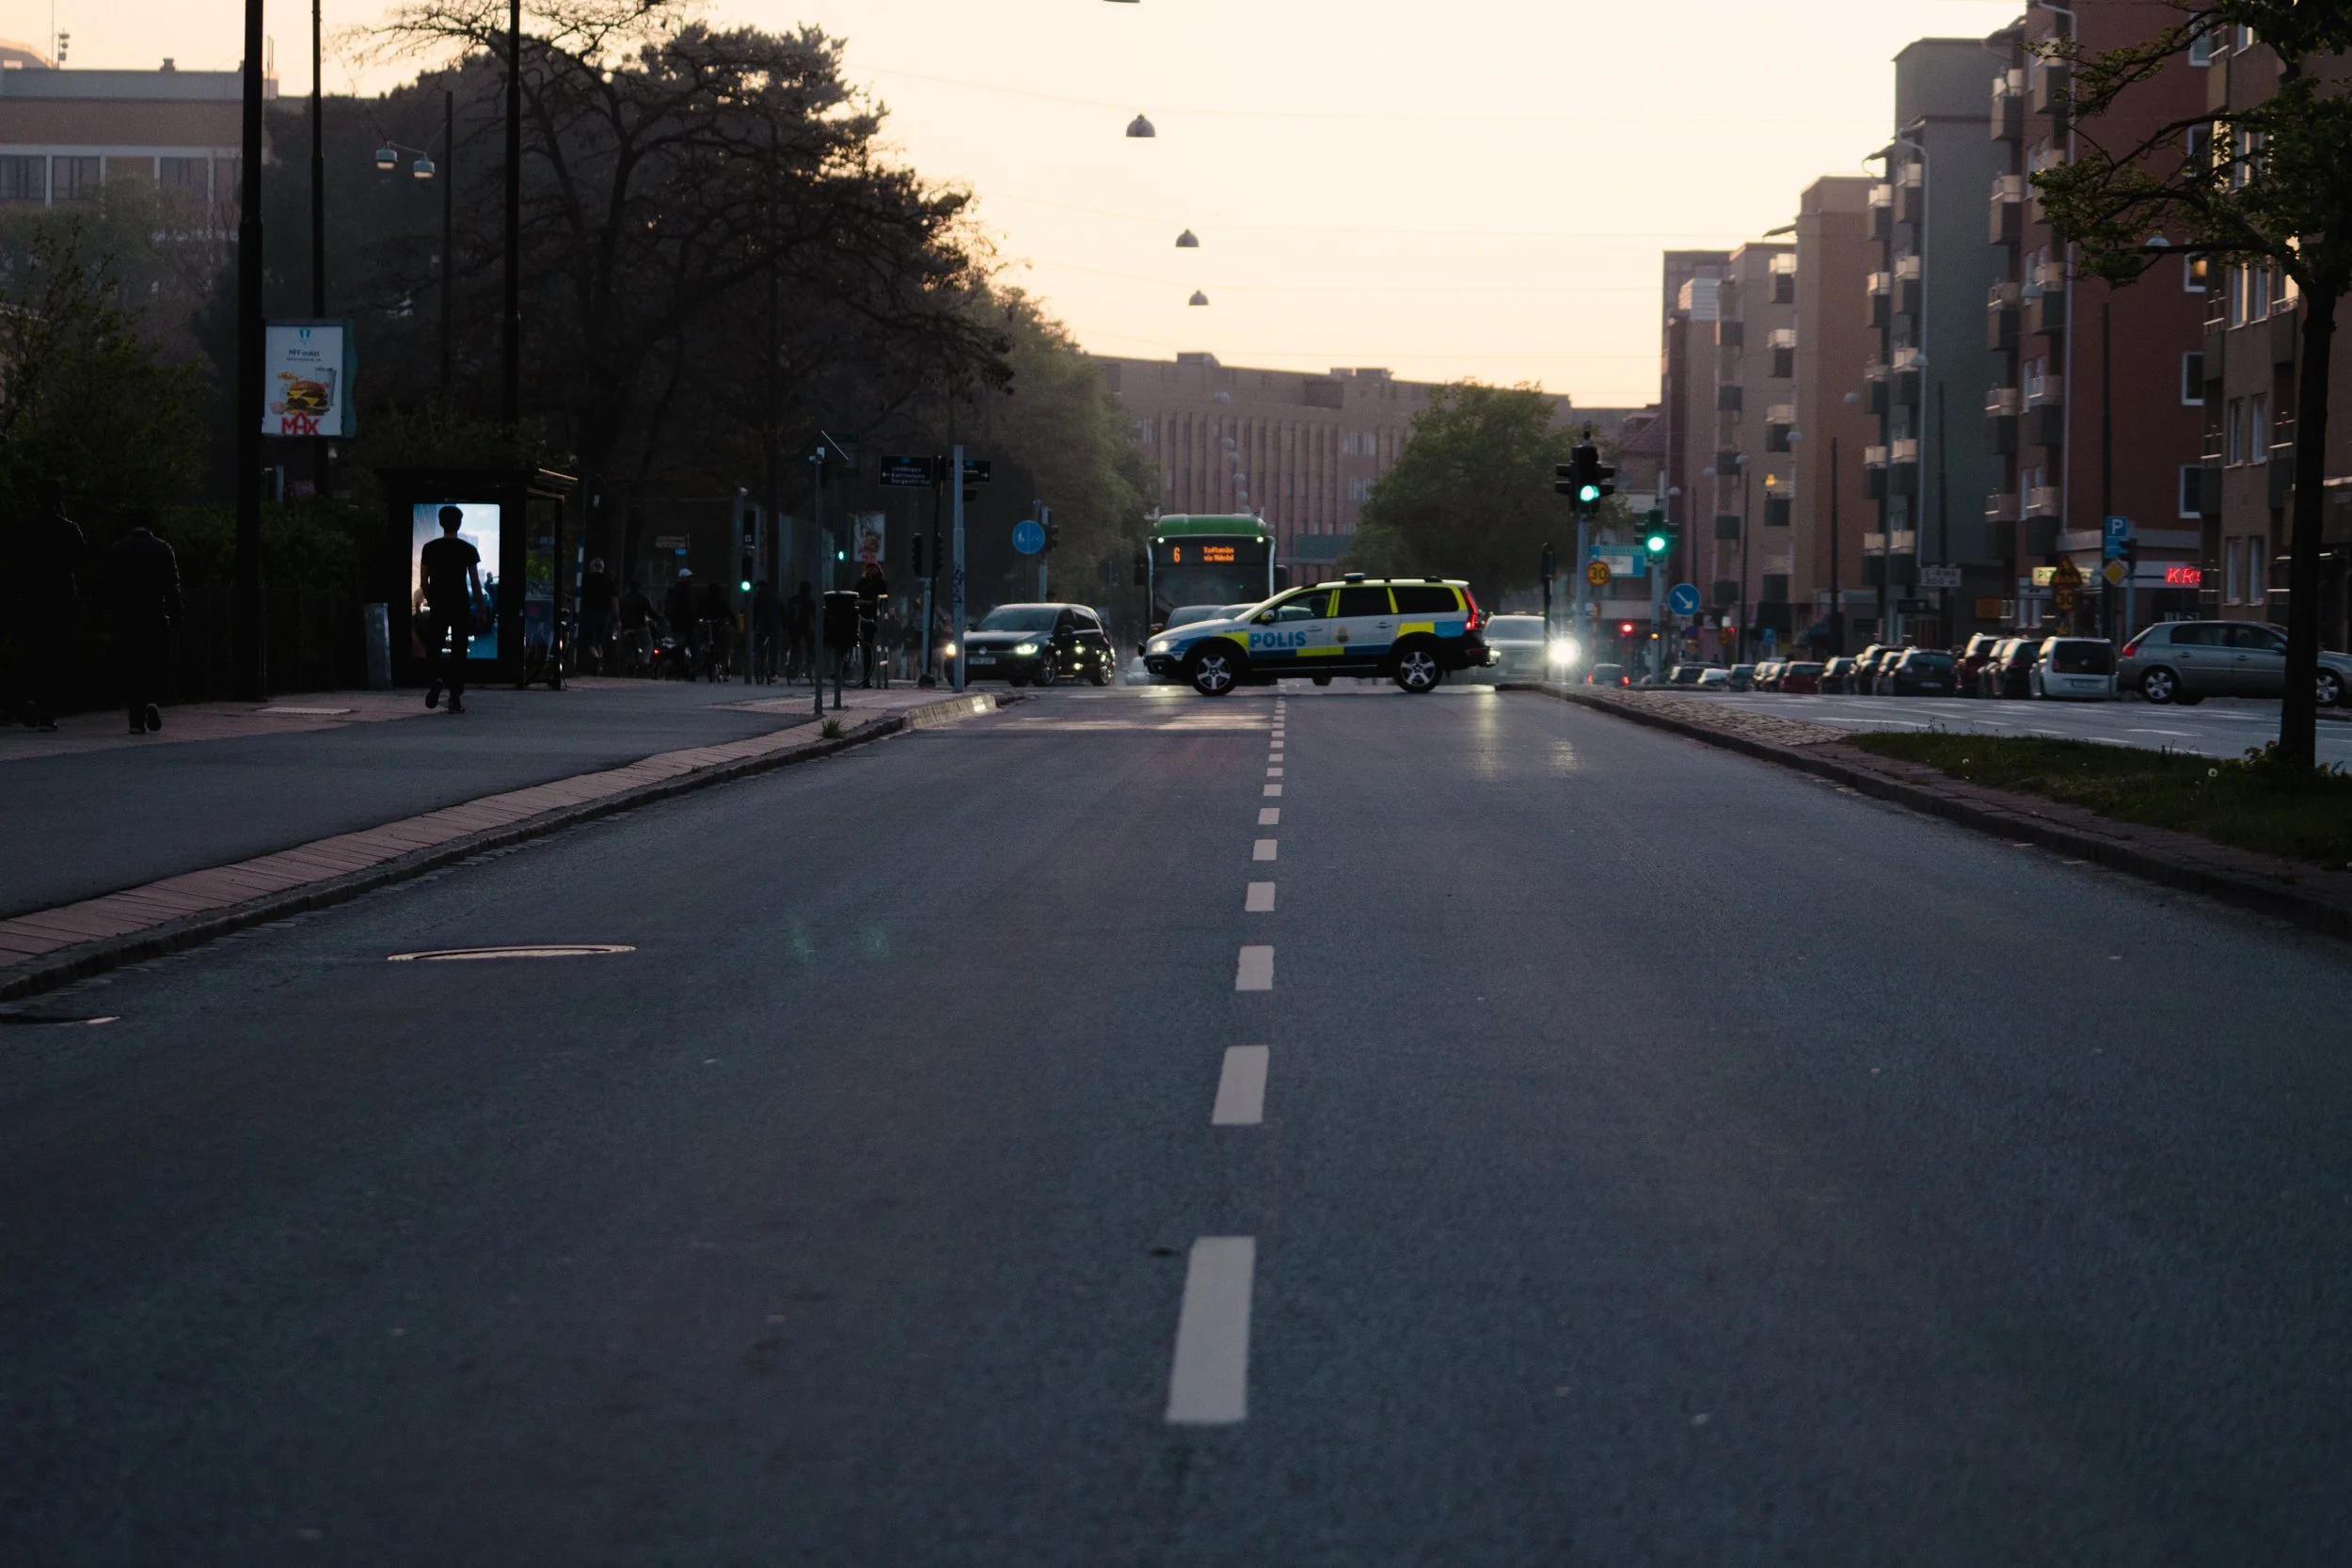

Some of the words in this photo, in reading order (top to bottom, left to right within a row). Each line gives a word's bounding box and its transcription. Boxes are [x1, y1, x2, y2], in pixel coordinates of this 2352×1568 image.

[282, 411, 320, 436] MAX
[2111, 519, 2123, 535] P
[1173, 546, 1181, 562] 6
[1591, 567, 1607, 579] 30
[2058, 590, 2074, 604] 30
[1249, 631, 1307, 648] POLIS
